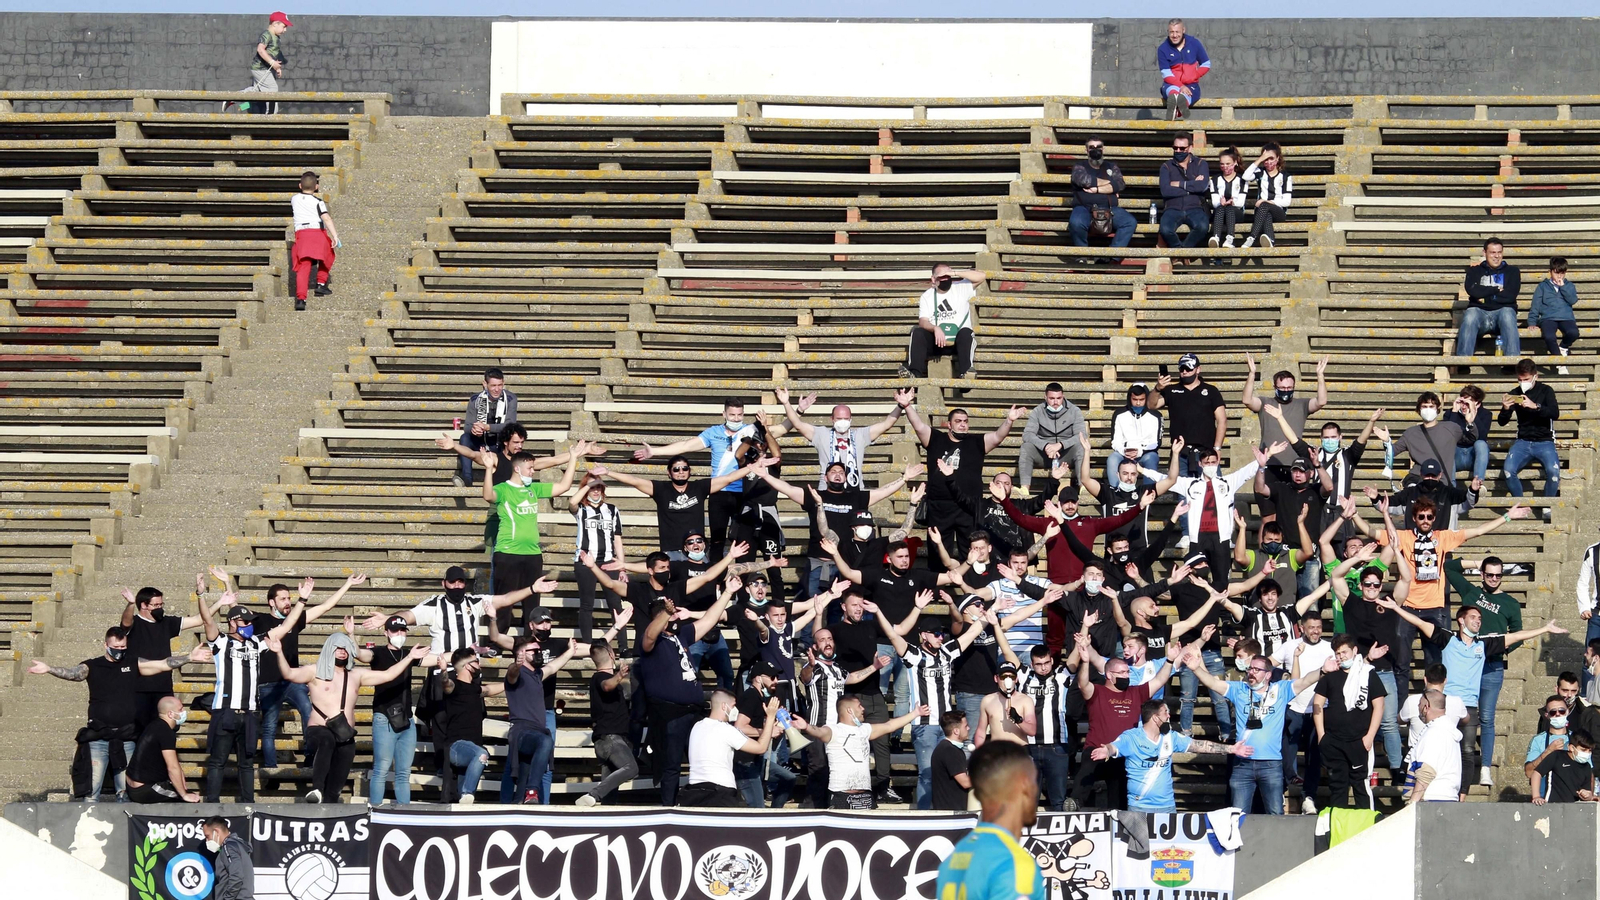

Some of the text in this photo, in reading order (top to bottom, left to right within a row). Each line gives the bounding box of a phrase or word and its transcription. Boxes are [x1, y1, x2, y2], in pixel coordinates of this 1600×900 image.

[516, 506, 538, 515] LOTU
[987, 507, 1006, 517] EARL
[585, 521, 614, 533] LOTUS
[391, 619, 407, 627] FILA
[231, 648, 259, 661] LOTUS
[923, 666, 954, 680] LOTUS
[1024, 684, 1056, 697] LOTUS
[1242, 706, 1276, 715] LUS
[1140, 758, 1169, 769] LOTUS
[252, 818, 370, 842] ULTRAS
[1021, 814, 1106, 836] LONA
[1114, 813, 1207, 841] IJO
[278, 844, 347, 869] AGAINST MODERN
[375, 828, 693, 900] COLECTIVO
